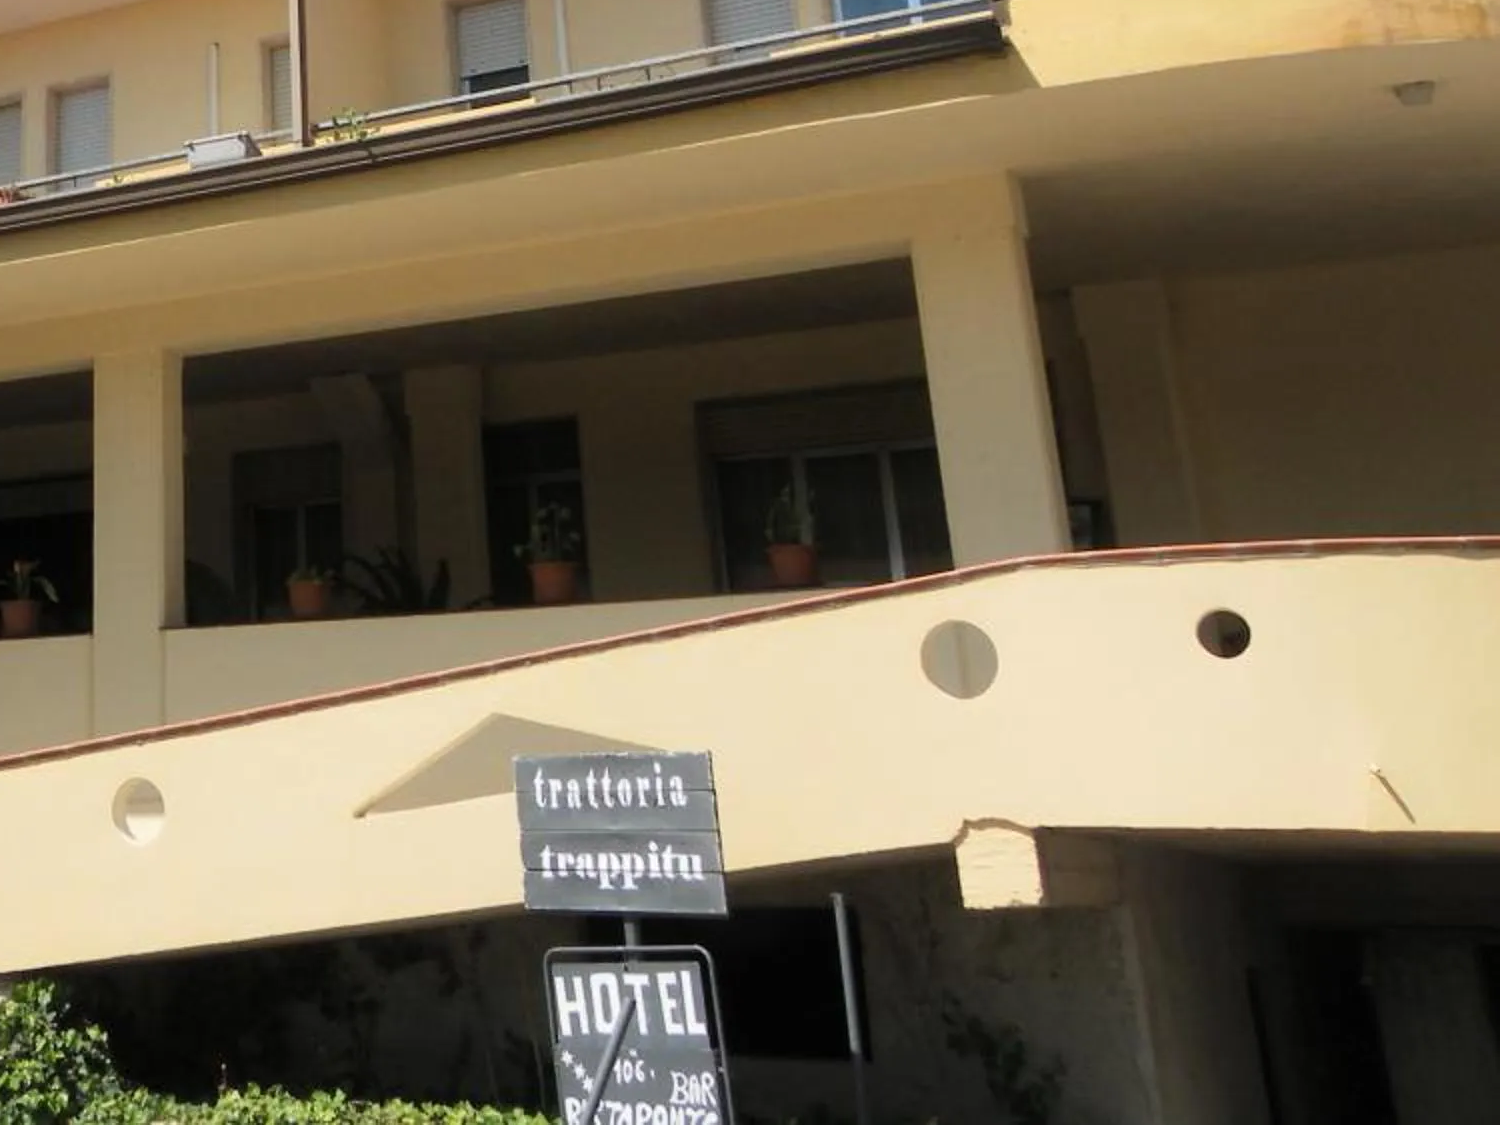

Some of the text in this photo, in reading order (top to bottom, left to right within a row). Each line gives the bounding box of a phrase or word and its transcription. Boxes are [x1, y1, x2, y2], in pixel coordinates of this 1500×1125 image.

[533, 763, 688, 810] trattoria
[540, 841, 705, 890] trappitu
[553, 970, 708, 1037] HOTEL
[669, 1070, 717, 1107] BAR
